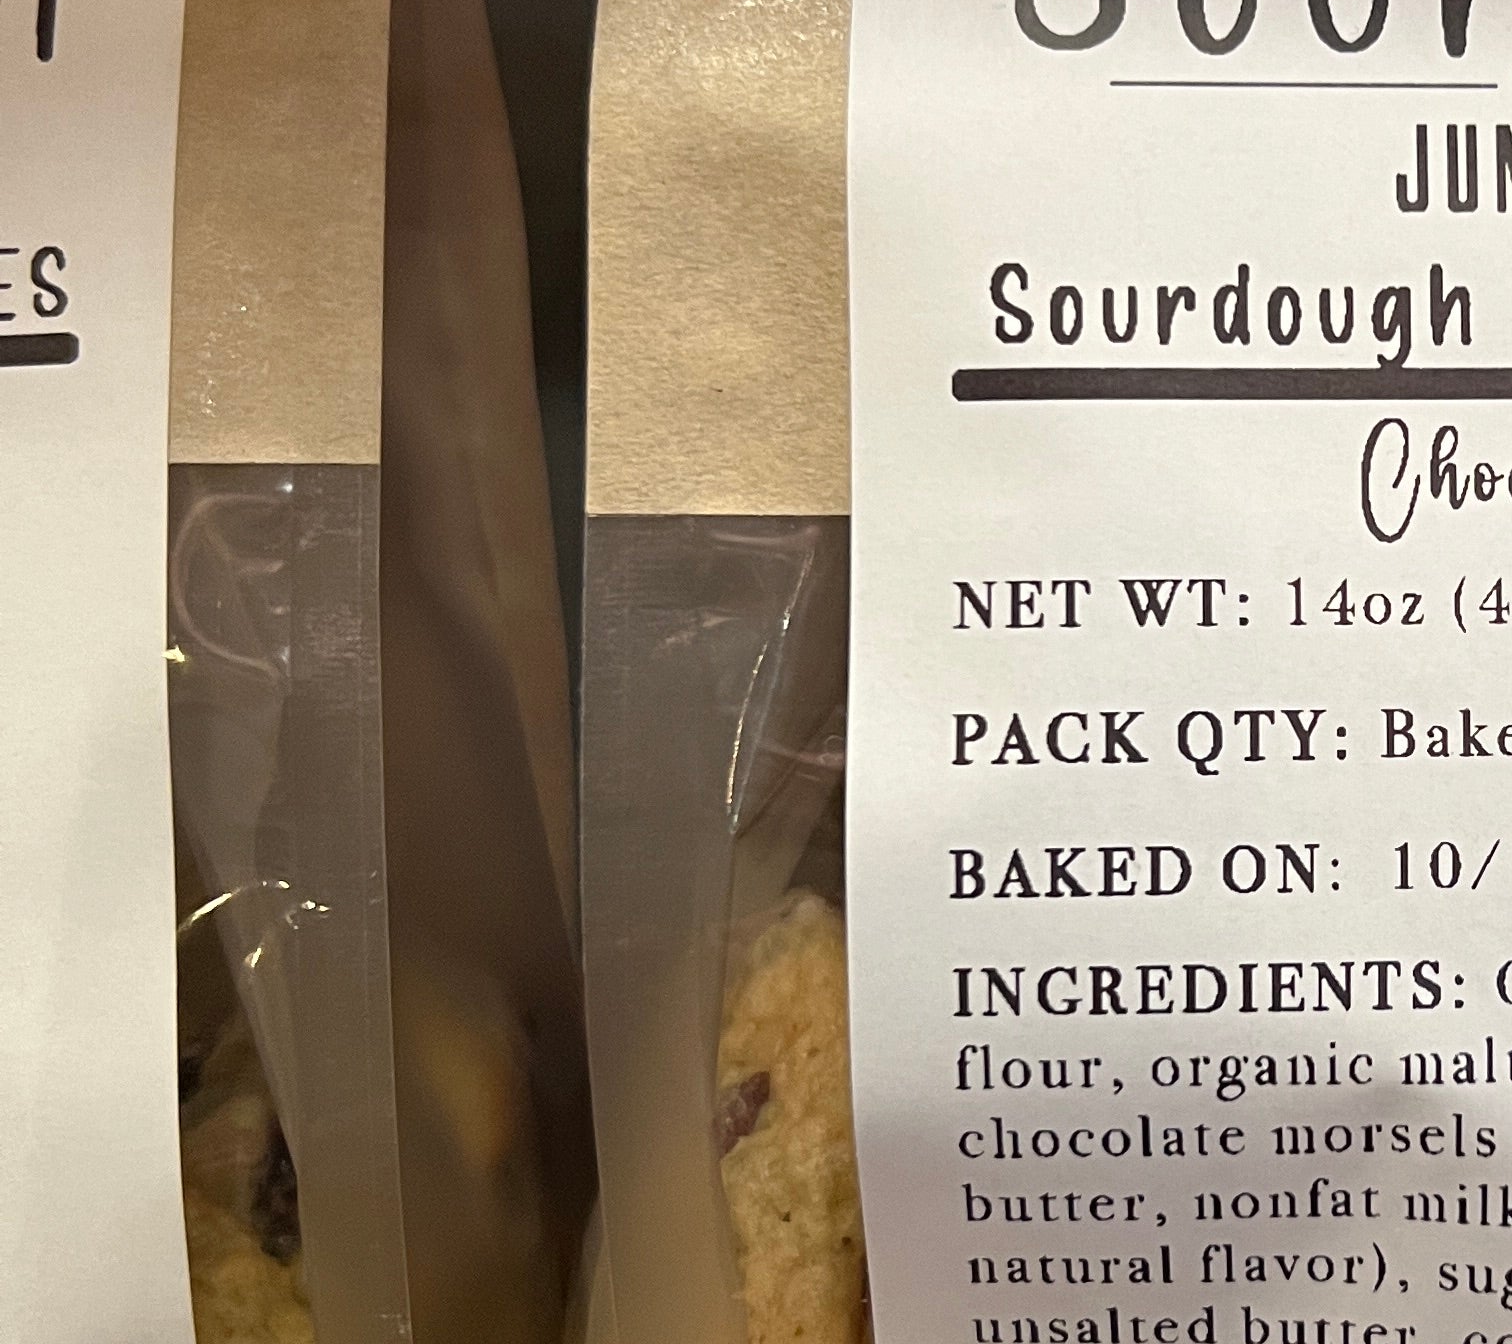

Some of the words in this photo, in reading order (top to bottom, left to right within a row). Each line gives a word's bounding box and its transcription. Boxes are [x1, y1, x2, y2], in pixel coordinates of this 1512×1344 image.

[988, 262, 1473, 365] Sourdough
[952, 579, 1092, 630] NET
[1118, 578, 1250, 628] WT:
[1287, 577, 1425, 627] 14oz
[951, 710, 1150, 767] PACK
[1176, 708, 1348, 777] QTY:
[948, 845, 1193, 900] BAKED
[1222, 843, 1340, 895] ON:
[952, 959, 1465, 1018] INGREDIENTS:
[955, 1043, 1124, 1096] flour,
[1151, 1041, 1373, 1103] organic
[957, 1114, 1246, 1160] chocolate
[1271, 1112, 1497, 1159] morsels
[961, 1182, 1168, 1228] butter,
[1194, 1176, 1380, 1221] nonfat
[967, 1244, 1174, 1285] natural
[1200, 1242, 1409, 1294] flavor),
